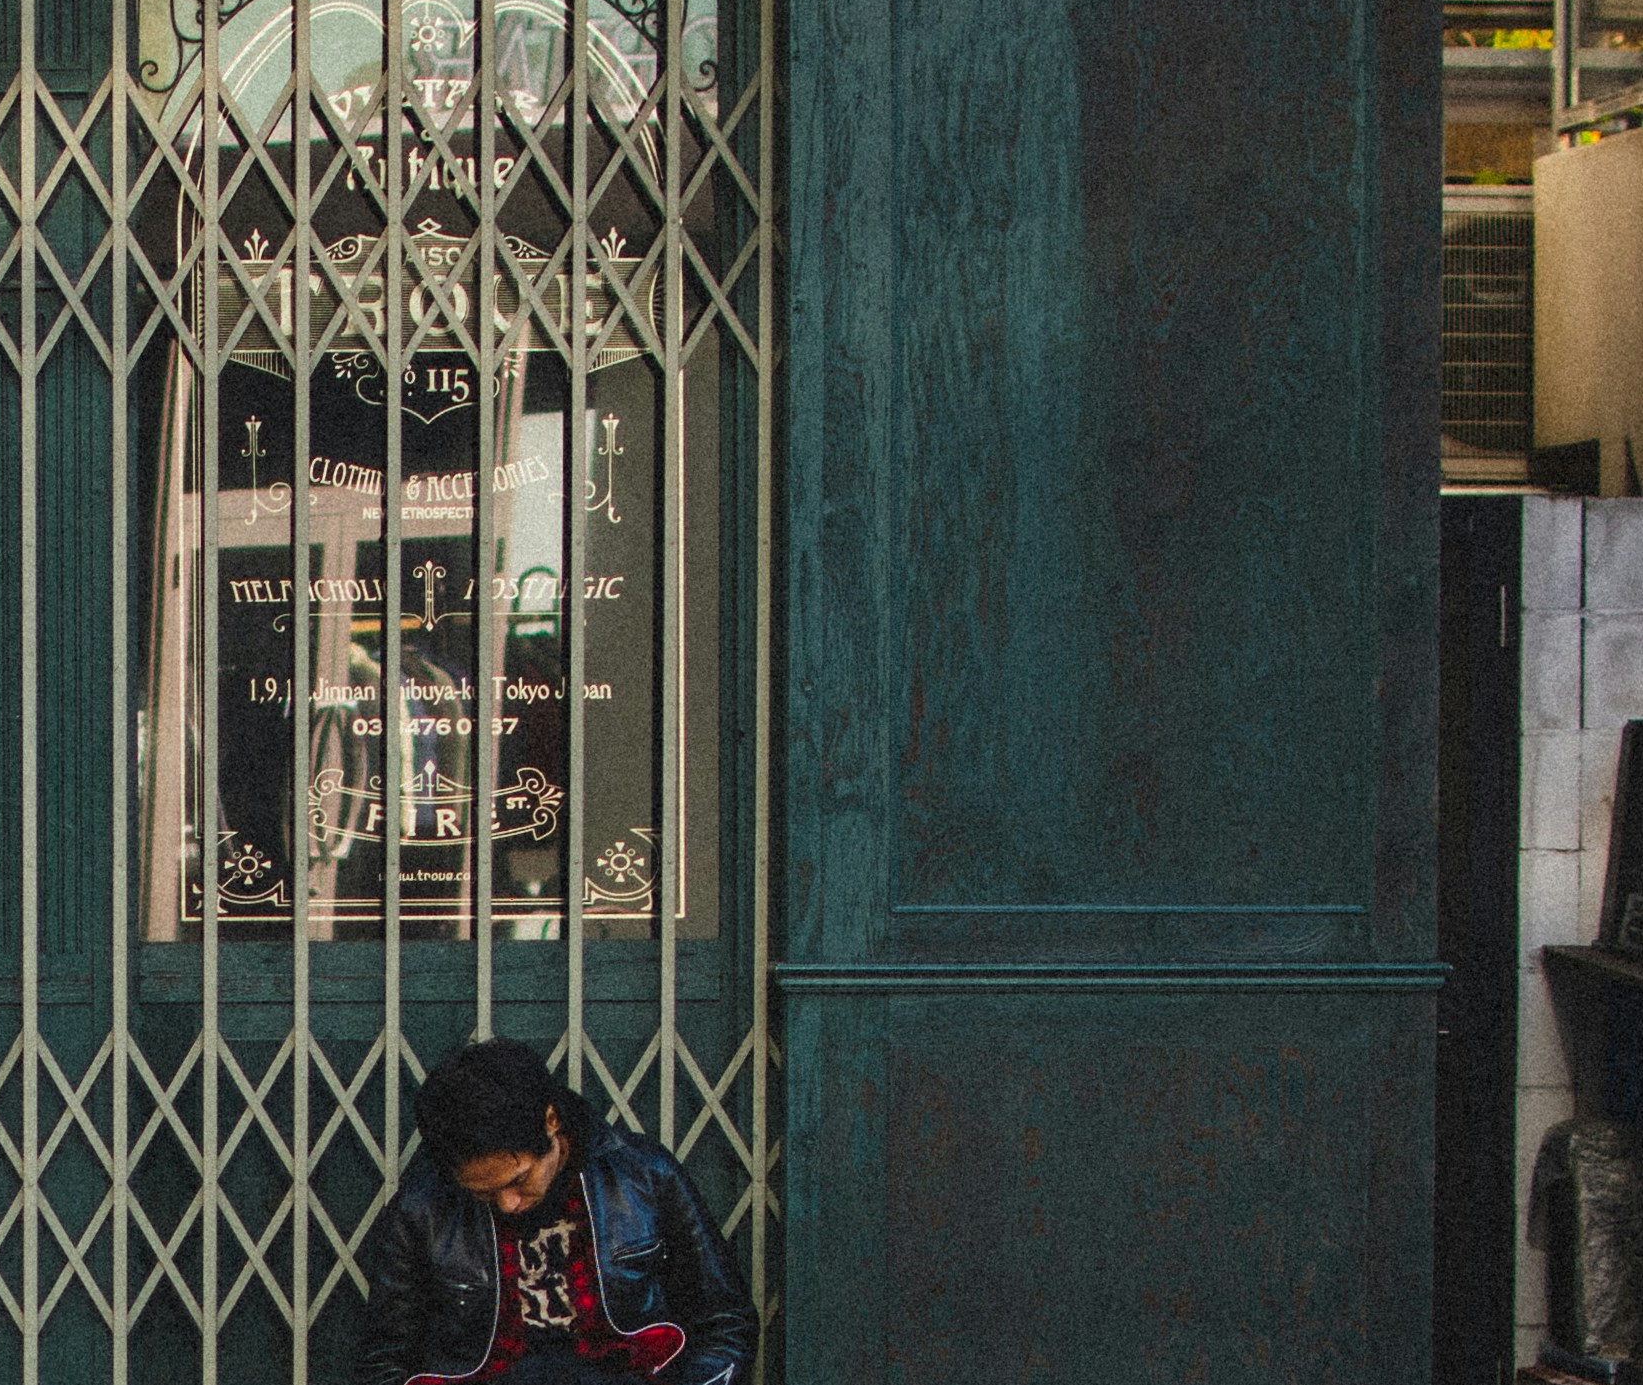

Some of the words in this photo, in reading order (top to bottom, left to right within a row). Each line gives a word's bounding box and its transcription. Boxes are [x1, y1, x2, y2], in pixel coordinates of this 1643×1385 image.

[309, 455, 388, 497] CLOTHIN
[405, 474, 423, 501] &
[427, 454, 550, 503] ACCEORIES
[493, 677, 550, 706] Tokyo
[351, 716, 383, 737] 03
